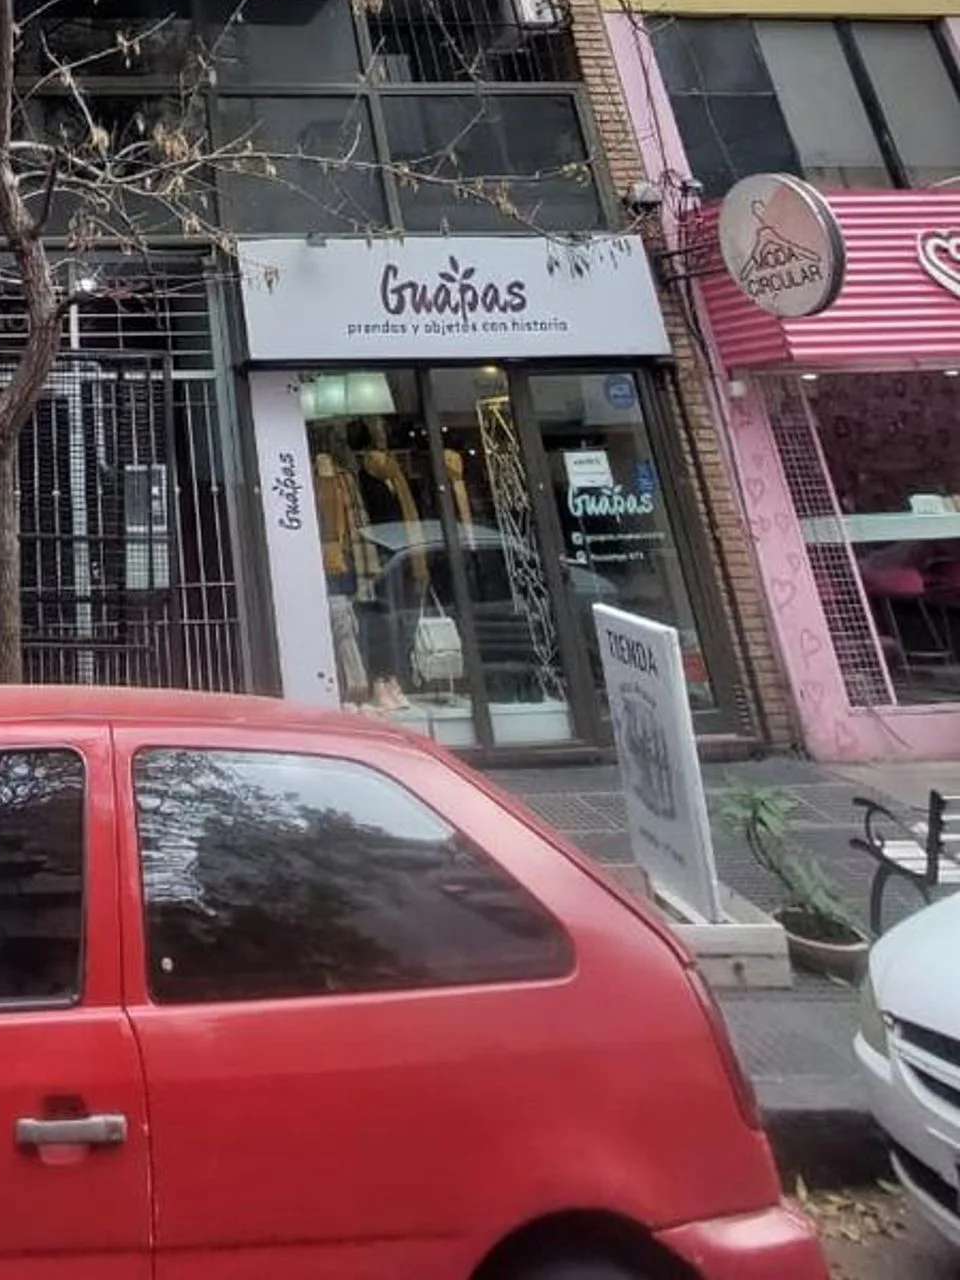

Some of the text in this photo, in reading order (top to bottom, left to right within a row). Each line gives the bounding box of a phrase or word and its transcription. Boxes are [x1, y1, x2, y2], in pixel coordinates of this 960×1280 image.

[751, 246, 799, 272] MODA
[380, 260, 528, 323] Guapas
[747, 265, 824, 297] CIRCULAR
[347, 318, 569, 336] prendas y objetos con historia
[277, 451, 303, 531] Guapas
[568, 482, 655, 523] Guapas
[606, 629, 658, 674] TIENDA
